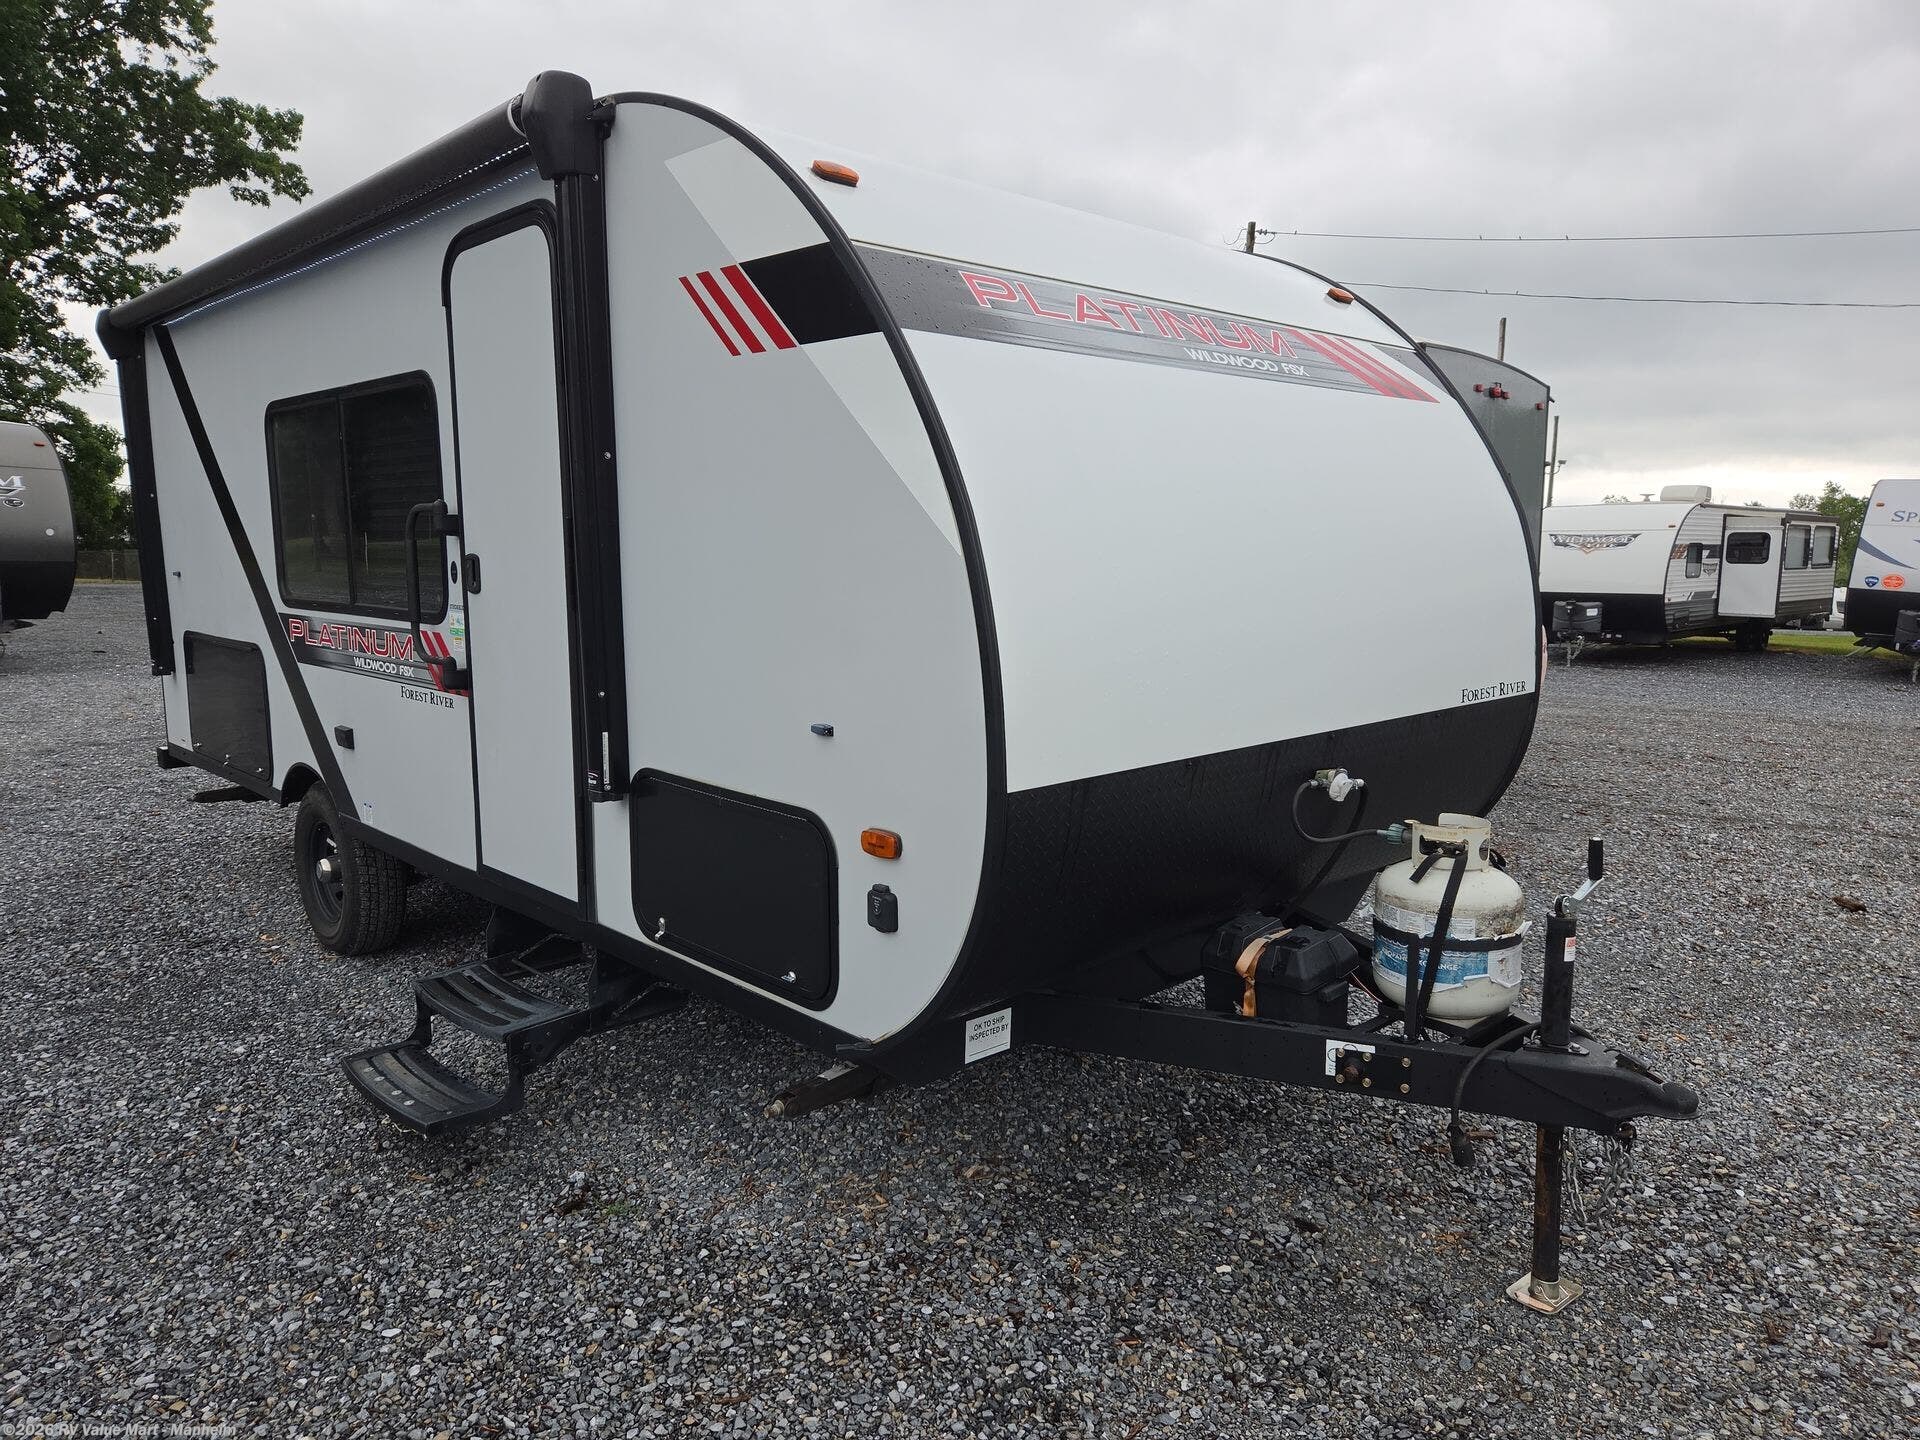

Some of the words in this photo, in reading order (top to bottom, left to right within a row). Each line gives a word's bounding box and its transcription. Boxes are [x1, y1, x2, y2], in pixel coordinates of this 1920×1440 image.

[958, 270, 1299, 360] PLATINUM
[1184, 348, 1278, 373] WILDWOOD
[1281, 361, 1311, 377] FSX
[288, 618, 414, 662] PLATINUM
[353, 656, 397, 674] WILDWOOD
[399, 665, 415, 678] FSX
[400, 685, 428, 704] FOREST
[429, 691, 455, 709] RIVER
[1461, 686, 1497, 703] FOREST
[1499, 680, 1527, 696] RIVER
[969, 1026, 1001, 1041] INSPECTED
[974, 1023, 983, 1031] OK
[984, 1020, 991, 1028] TO
[992, 1016, 1005, 1025] SHIP
